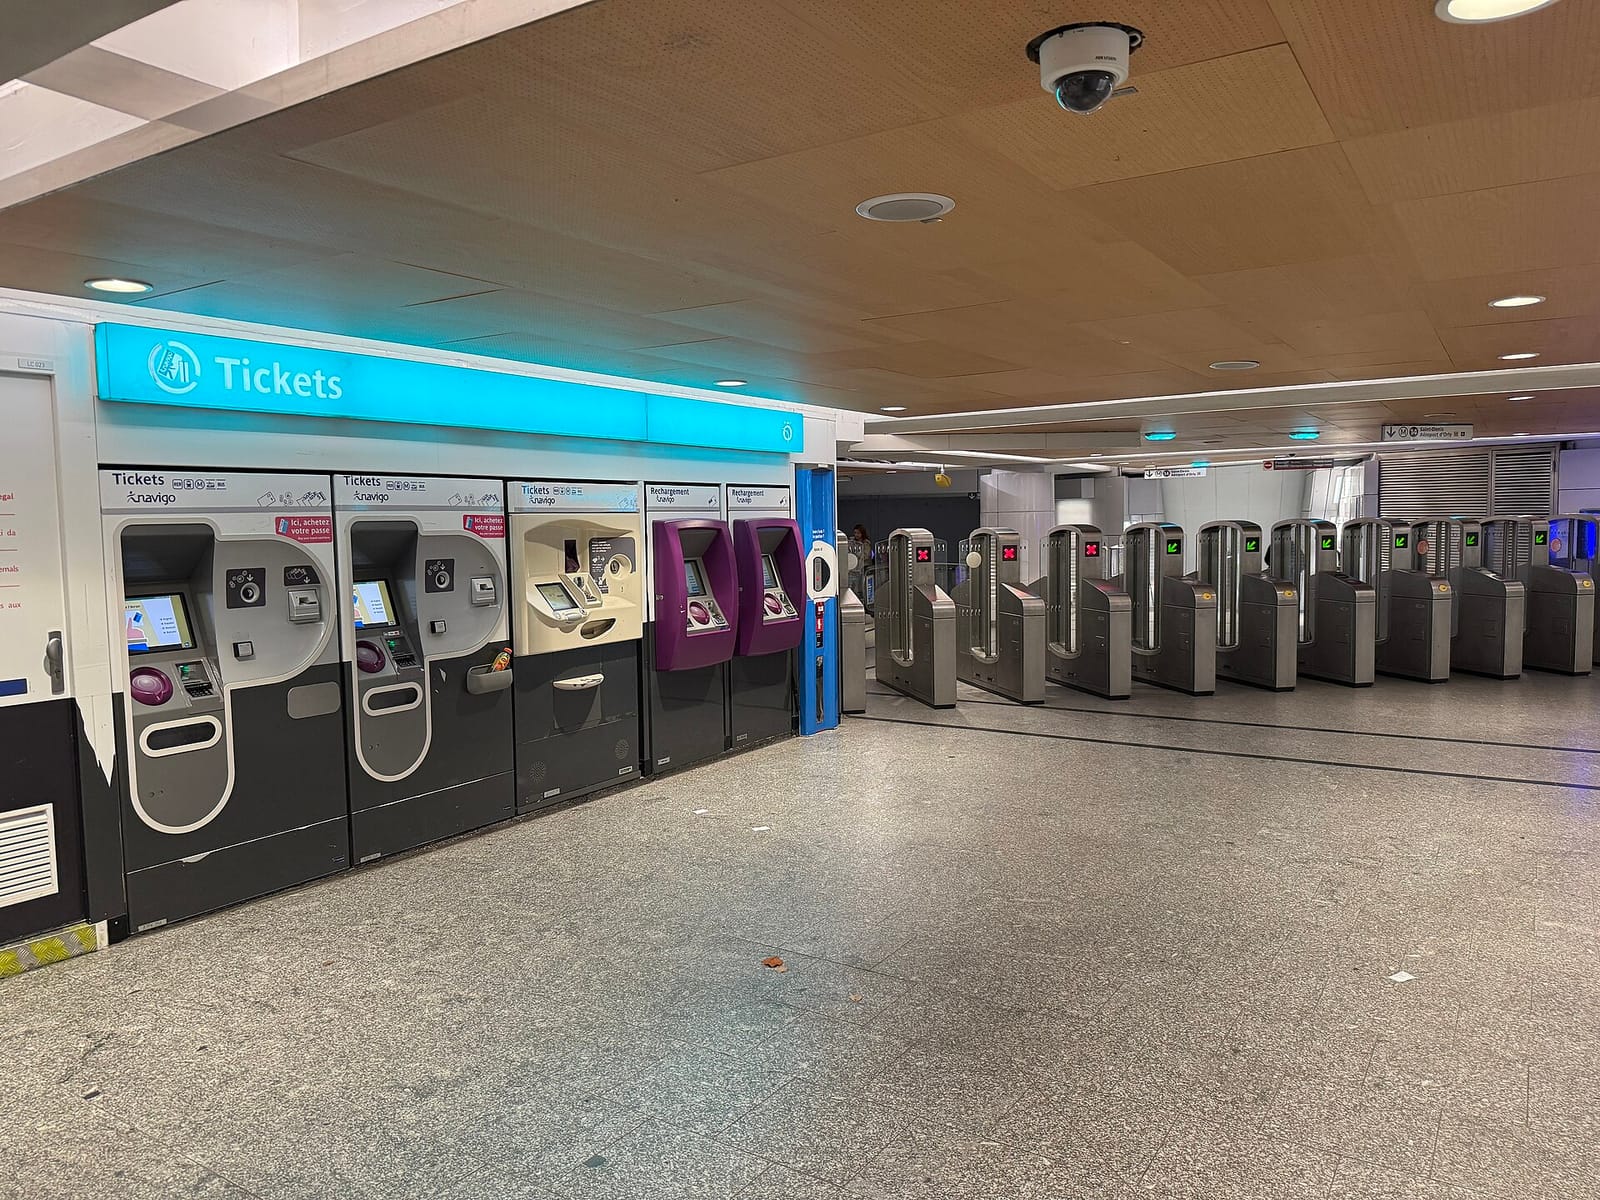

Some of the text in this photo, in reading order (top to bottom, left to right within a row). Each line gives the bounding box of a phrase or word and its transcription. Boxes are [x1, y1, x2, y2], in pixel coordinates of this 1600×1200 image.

[215, 357, 342, 399] Tickets
[112, 473, 164, 486] Tickets
[344, 476, 380, 486] Tickets
[521, 484, 550, 494] Tickets
[650, 488, 690, 496] Rechargement
[732, 489, 764, 497] Rechargement
[135, 492, 176, 505] navigo
[360, 492, 389, 503] navigo
[290, 518, 330, 526] Ici, achetez
